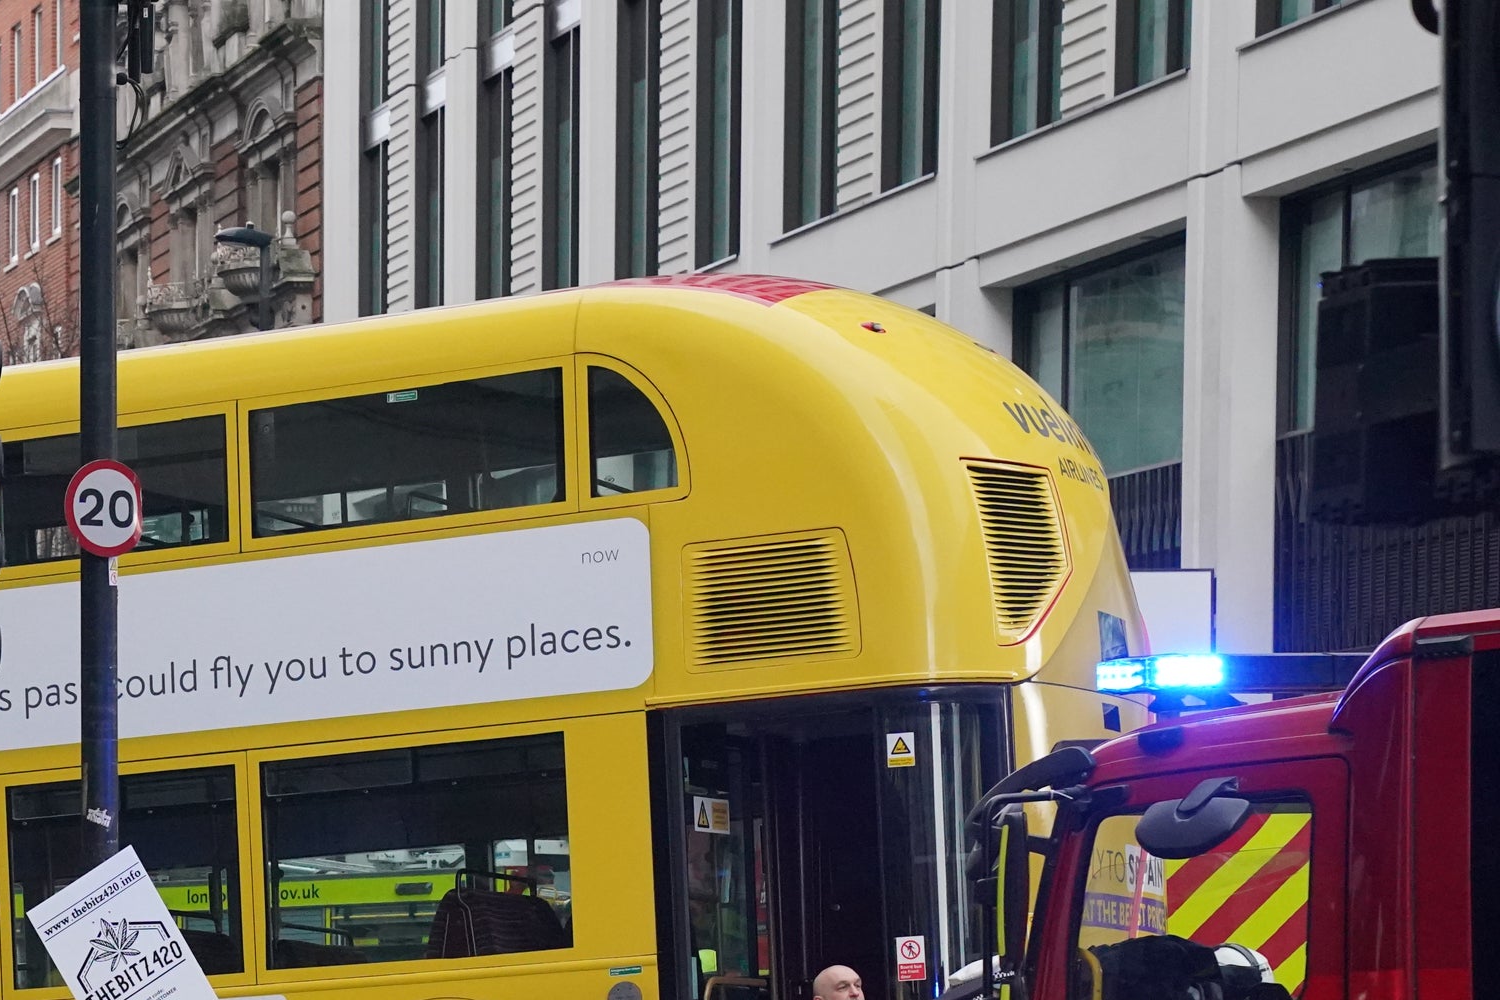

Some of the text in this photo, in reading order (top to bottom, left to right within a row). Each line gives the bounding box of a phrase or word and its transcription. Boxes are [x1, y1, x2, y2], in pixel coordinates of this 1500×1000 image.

[78, 488, 135, 529] 20
[580, 547, 620, 564] now
[25, 681, 78, 719] pas
[210, 655, 254, 698] fly
[264, 655, 328, 694] you
[339, 647, 377, 676] to
[389, 638, 494, 673] sunny
[506, 623, 632, 670] places.
[1106, 850, 1125, 883] TO
[43, 868, 141, 937] www.thebitz420.info
